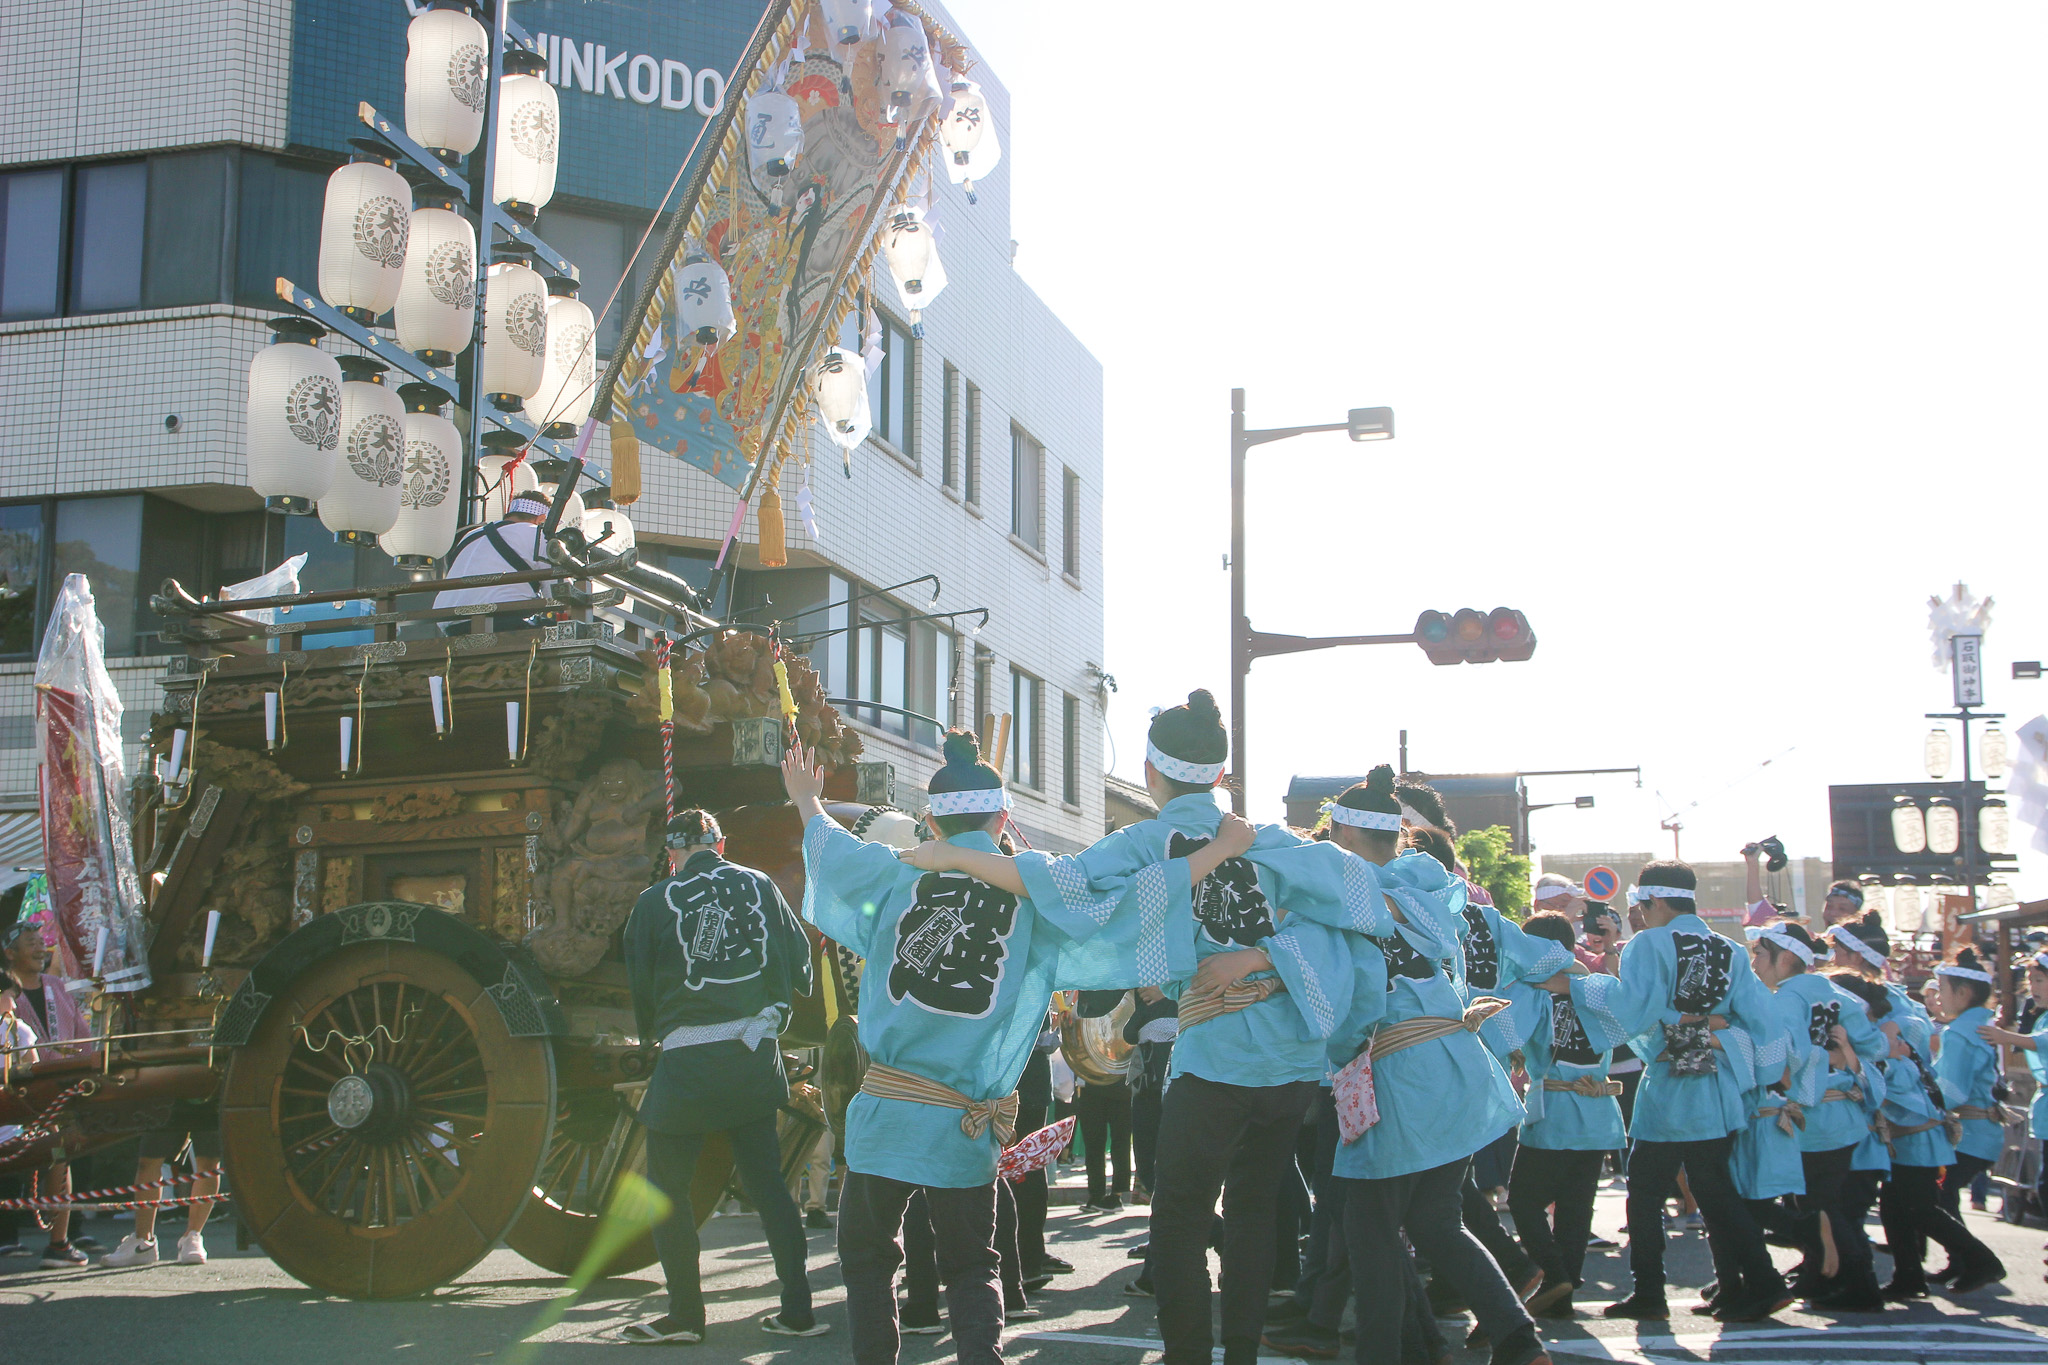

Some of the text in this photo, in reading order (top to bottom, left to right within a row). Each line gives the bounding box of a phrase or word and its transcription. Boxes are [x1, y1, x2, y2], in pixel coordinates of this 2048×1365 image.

[503, 31, 726, 118] INKODO
[376, 206, 400, 235] 大
[448, 251, 469, 276] 大
[310, 386, 334, 415] 大
[370, 424, 395, 451] 大
[405, 450, 433, 475] 大
